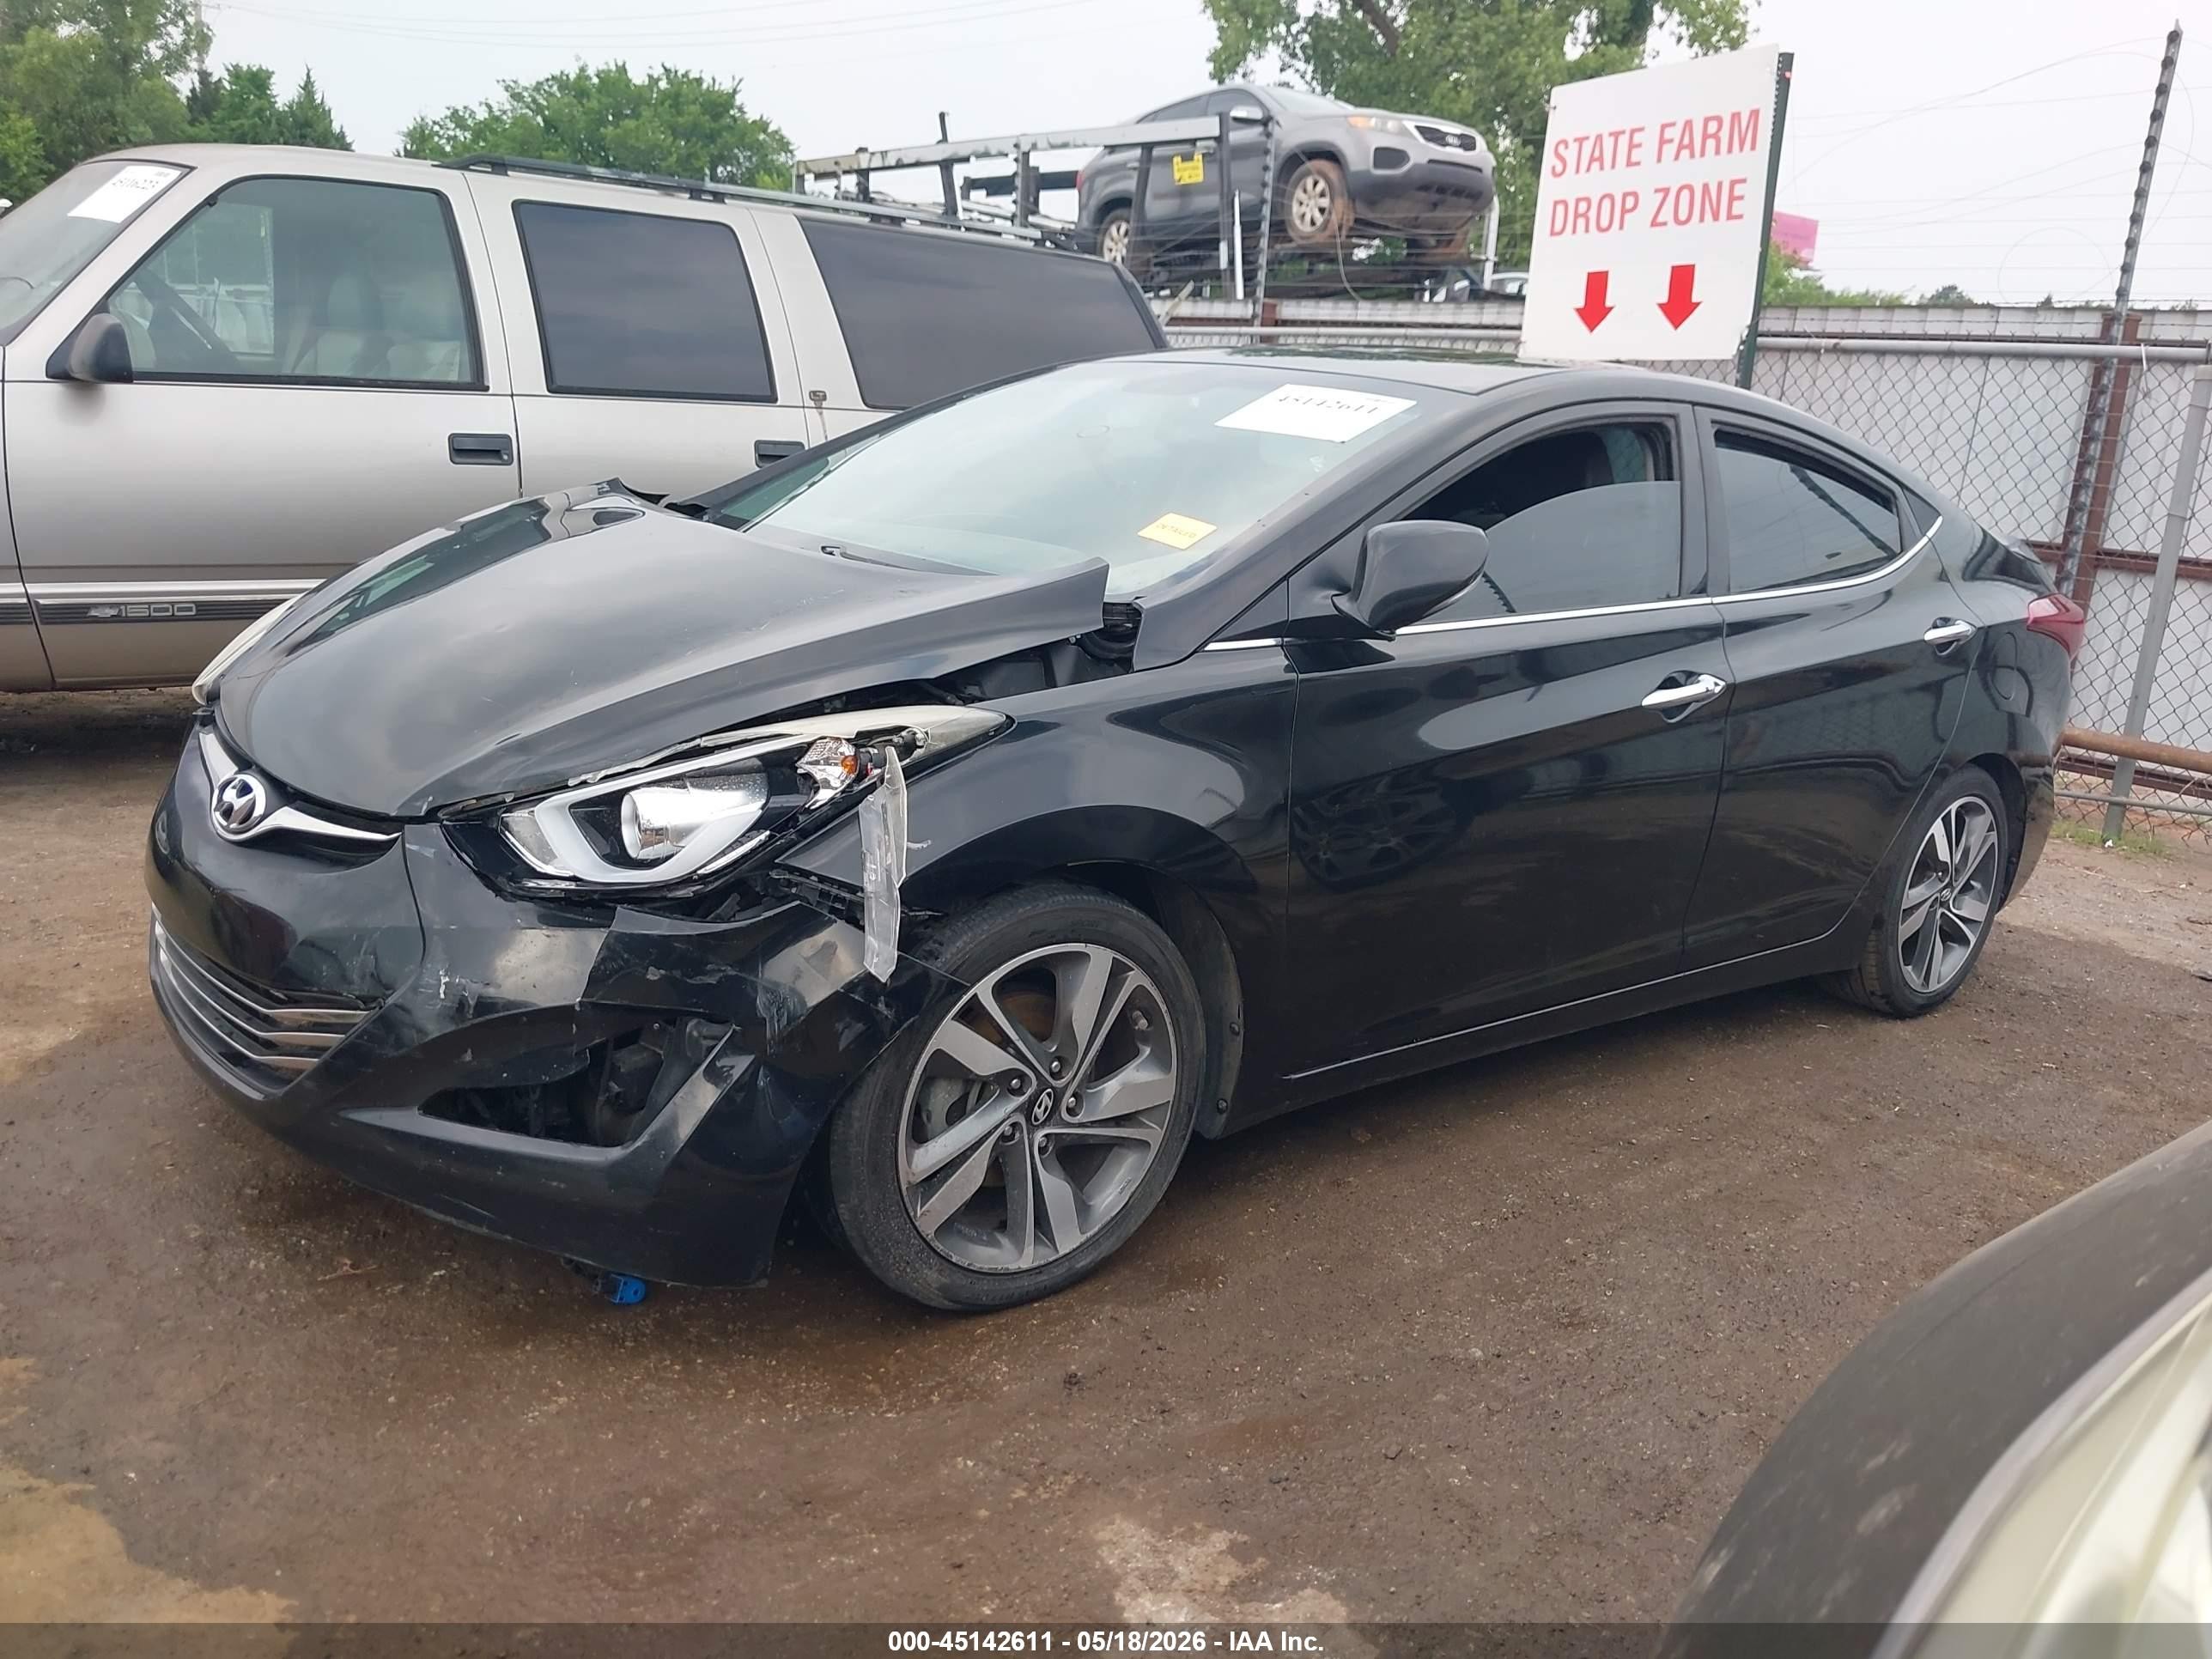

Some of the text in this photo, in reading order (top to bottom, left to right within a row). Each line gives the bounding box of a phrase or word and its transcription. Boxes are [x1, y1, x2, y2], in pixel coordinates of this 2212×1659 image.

[1551, 108, 1760, 178] STATE FARM
[1549, 178, 1747, 237] DROP ZONE
[120, 604, 197, 617] 1500
